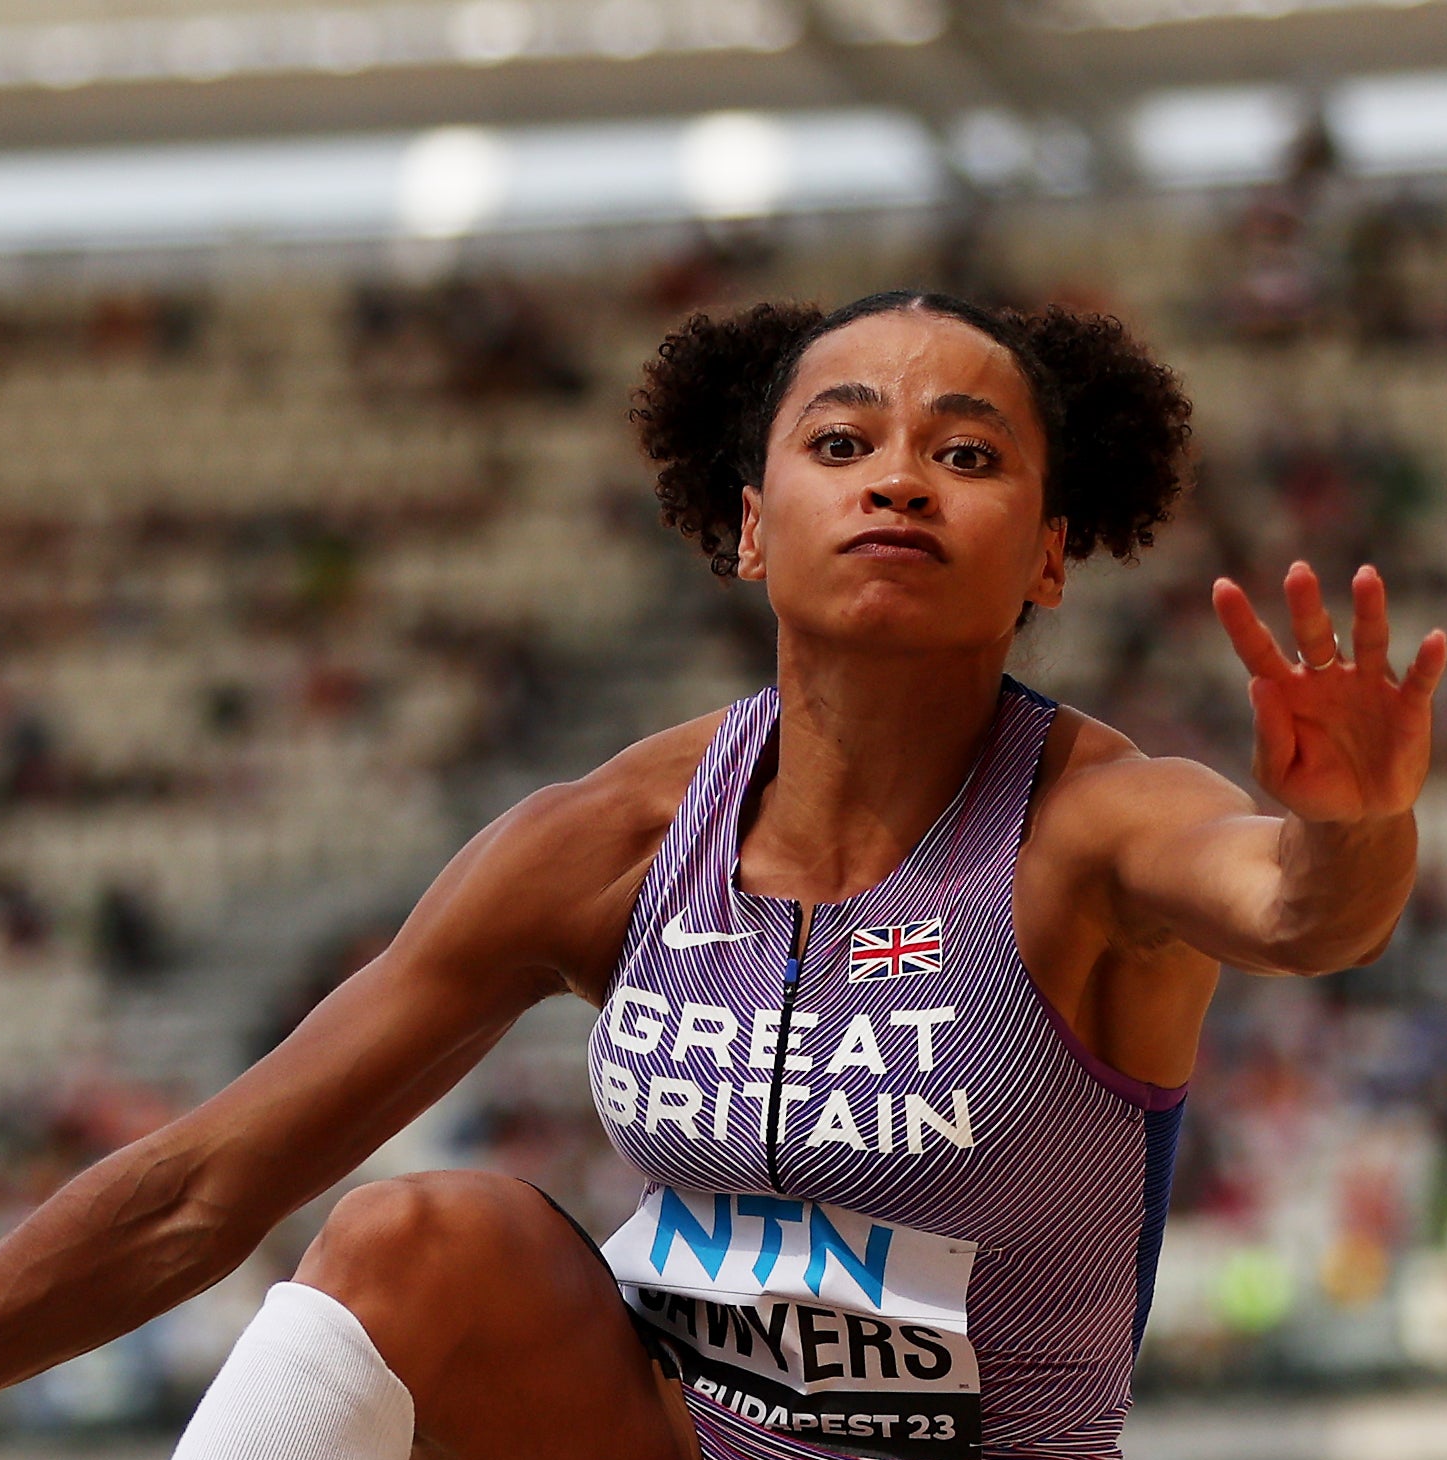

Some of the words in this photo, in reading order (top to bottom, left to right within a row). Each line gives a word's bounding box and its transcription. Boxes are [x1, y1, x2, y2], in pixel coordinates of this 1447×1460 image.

[608, 985, 956, 1075] GREAT
[601, 1058, 976, 1155] BRITAIN
[649, 1185, 894, 1310] NTN
[907, 1414, 956, 1441] 23
